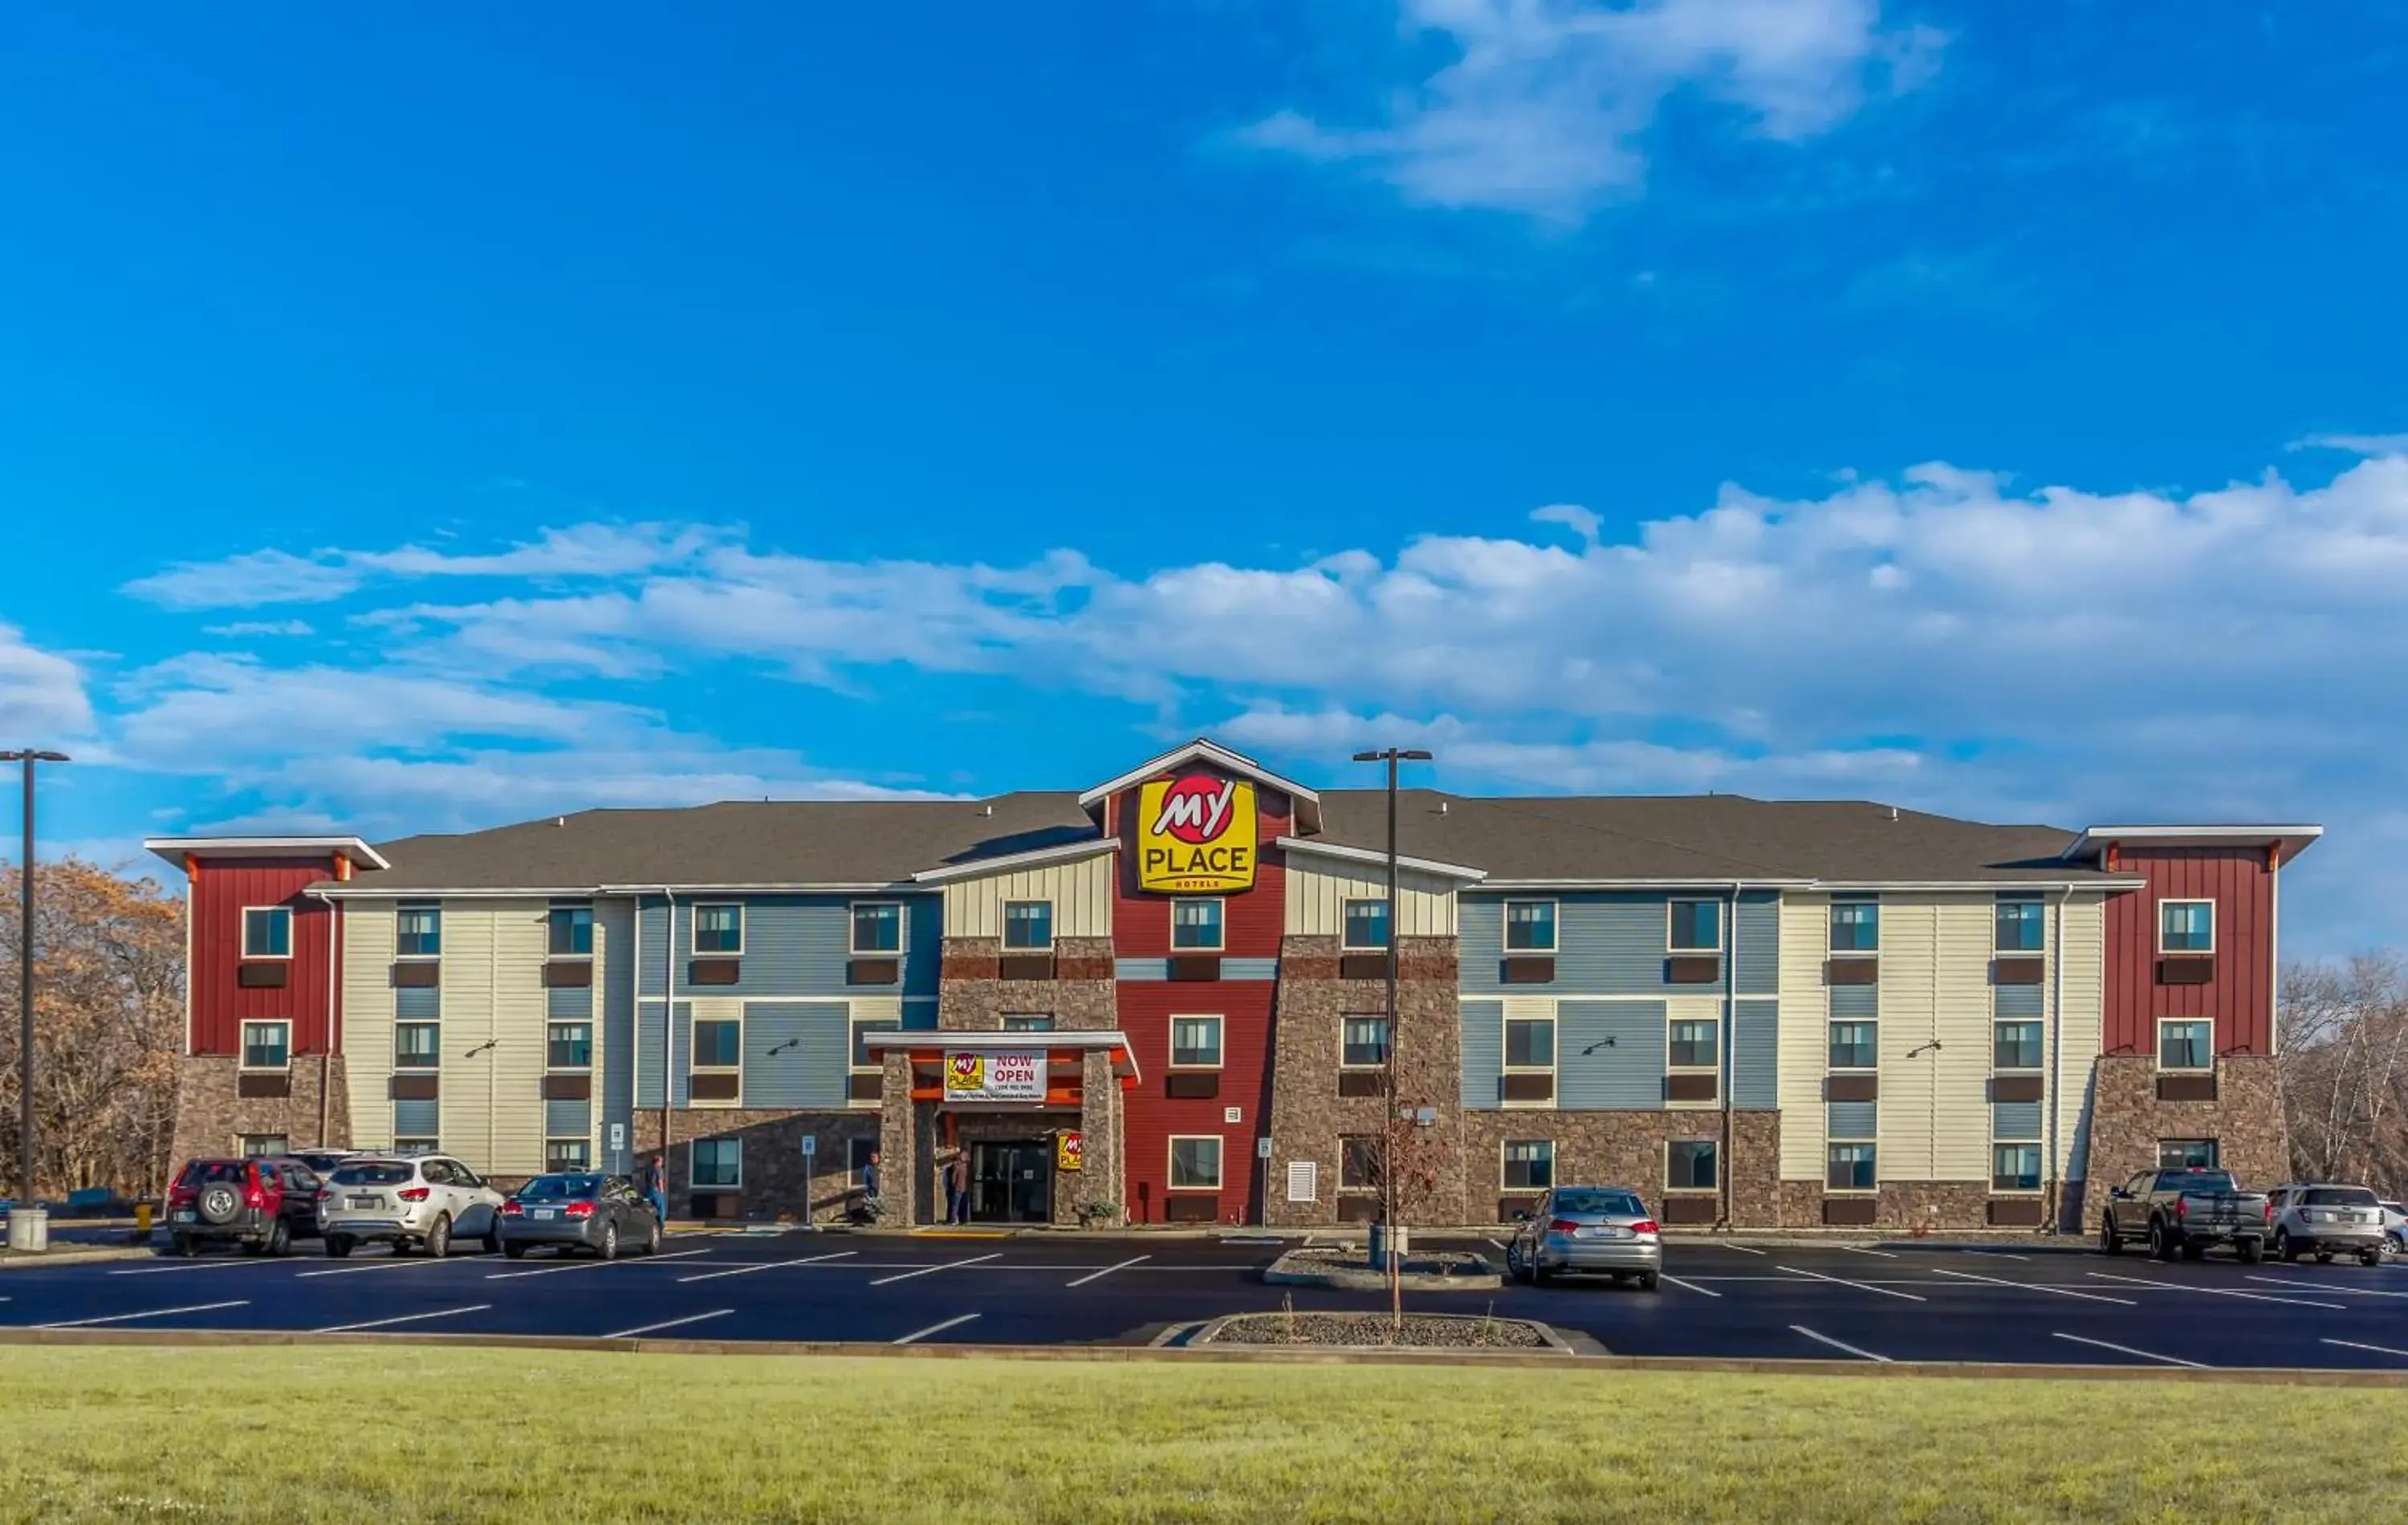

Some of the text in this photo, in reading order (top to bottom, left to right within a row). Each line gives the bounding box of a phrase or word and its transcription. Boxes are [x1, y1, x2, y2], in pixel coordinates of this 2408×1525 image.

[1145, 847, 1249, 872] PLACE
[1175, 880, 1219, 889] HOTELS
[996, 1055, 1033, 1067] NOW
[950, 1075, 981, 1084] PLACE
[995, 1070, 1035, 1082] OPEN
